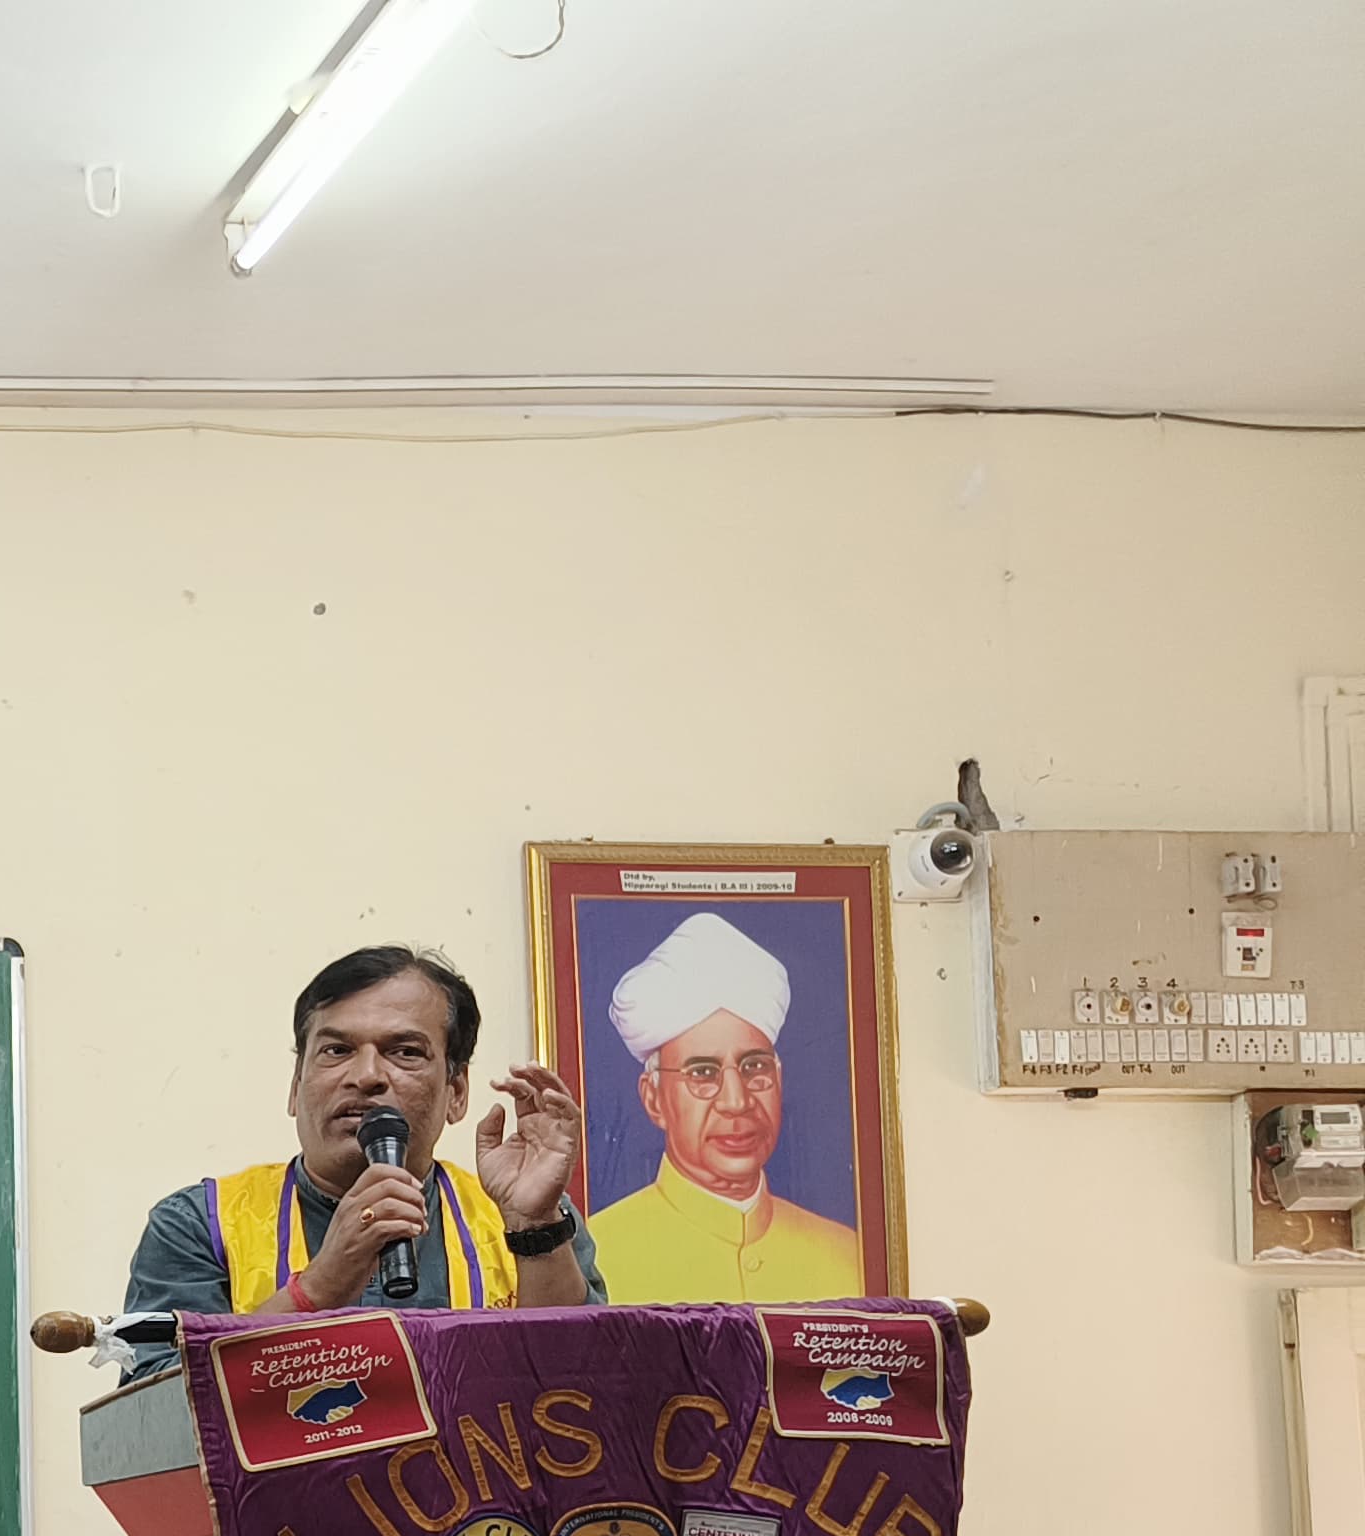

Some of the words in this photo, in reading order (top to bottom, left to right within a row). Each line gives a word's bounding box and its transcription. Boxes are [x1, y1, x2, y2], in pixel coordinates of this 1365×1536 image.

[671, 882, 713, 891] Students
[1109, 977, 1120, 990] 2
[1137, 976, 1149, 990] 3
[1166, 976, 1179, 990] 4
[792, 1331, 909, 1353] Retention
[249, 1343, 371, 1378] Retention
[267, 1352, 394, 1390] Campaign
[808, 1348, 927, 1377] Campaign
[303, 1424, 365, 1445] 2011-2012
